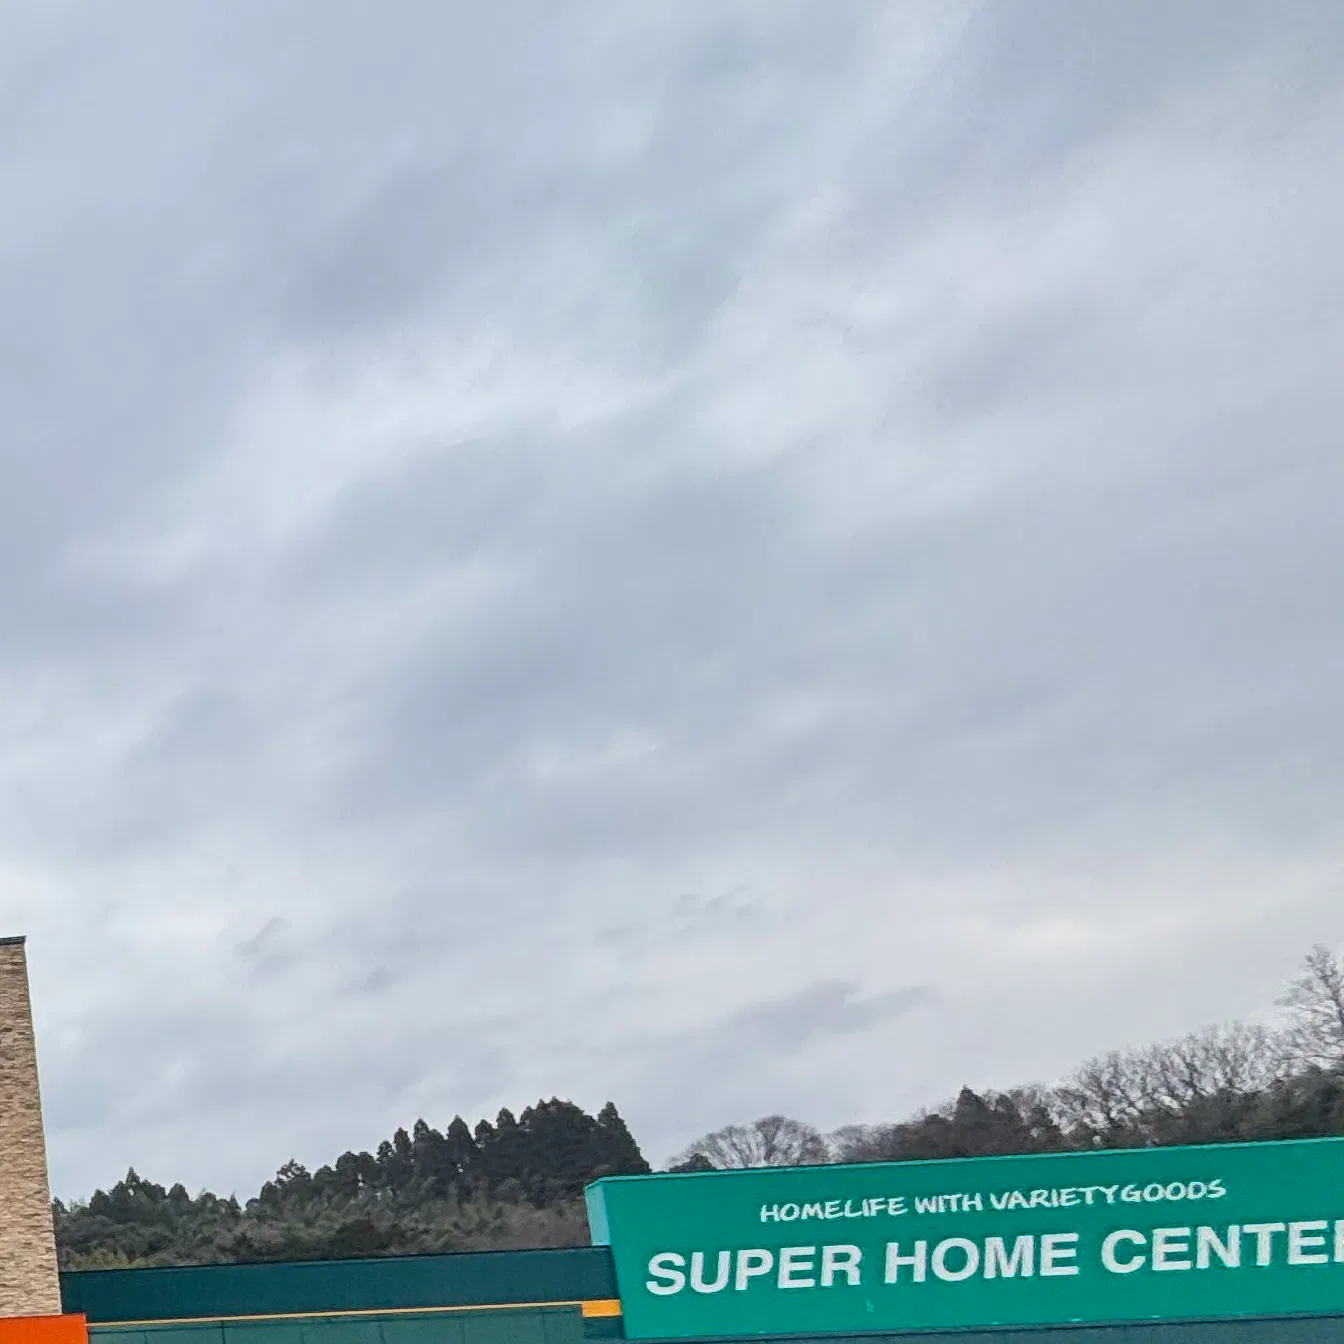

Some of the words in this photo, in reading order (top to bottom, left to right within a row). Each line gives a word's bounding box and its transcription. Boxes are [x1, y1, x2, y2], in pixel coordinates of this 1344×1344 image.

[760, 1196, 909, 1223] HOMELIFE
[914, 1192, 983, 1214] WITH
[645, 1244, 863, 1296] SUPER
[884, 1232, 1080, 1284] HOME
[1101, 1219, 1344, 1274] CENTE
